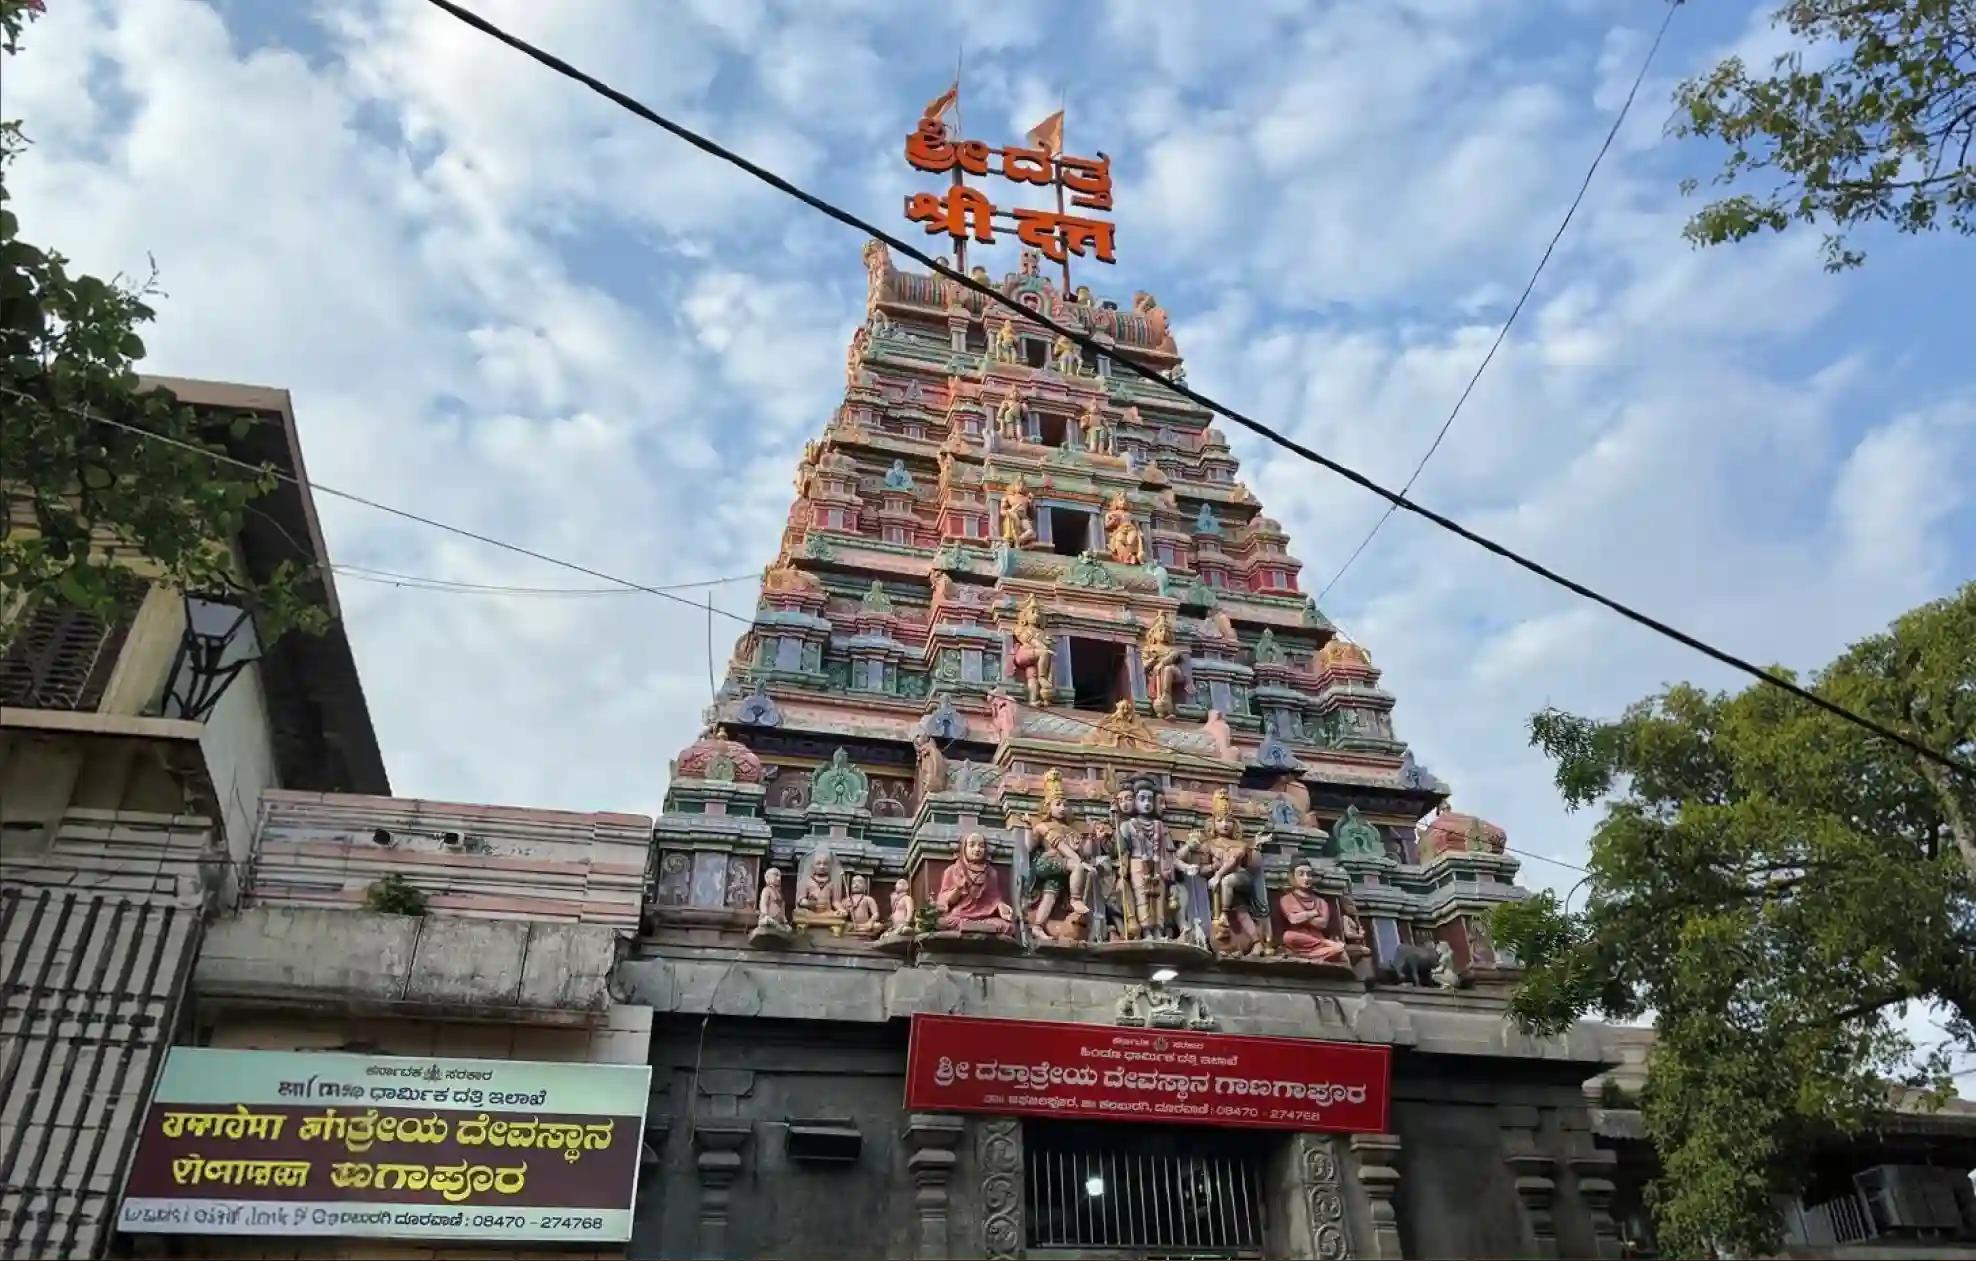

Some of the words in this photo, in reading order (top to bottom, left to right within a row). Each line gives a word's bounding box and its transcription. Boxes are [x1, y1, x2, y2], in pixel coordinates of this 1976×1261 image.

[904, 184, 996, 245] श्री
[445, 1067, 493, 1082] ಸರಕಾರ
[934, 1056, 970, 1087] ಶ್ರೀ
[975, 1058, 1098, 1090] ದತ್ತಾತ್ರೇಯ
[1103, 1066, 1210, 1100] ದೇವಸ್ಥಾನ
[1214, 1077, 1367, 1108] ಗಾಣಗಾಪೂರ
[370, 1085, 449, 1102] ಧಾರ್ಮಿಕ
[453, 1087, 484, 1108] ದತ್ತಿ
[488, 1089, 547, 1106] ಇಲಾಖೆ
[1216, 1106, 1258, 1117] 08470
[456, 1112, 614, 1164] ದೇವಸ್ಥಾನ
[472, 1215, 525, 1228] 08470
[540, 1216, 603, 1230] 274768
